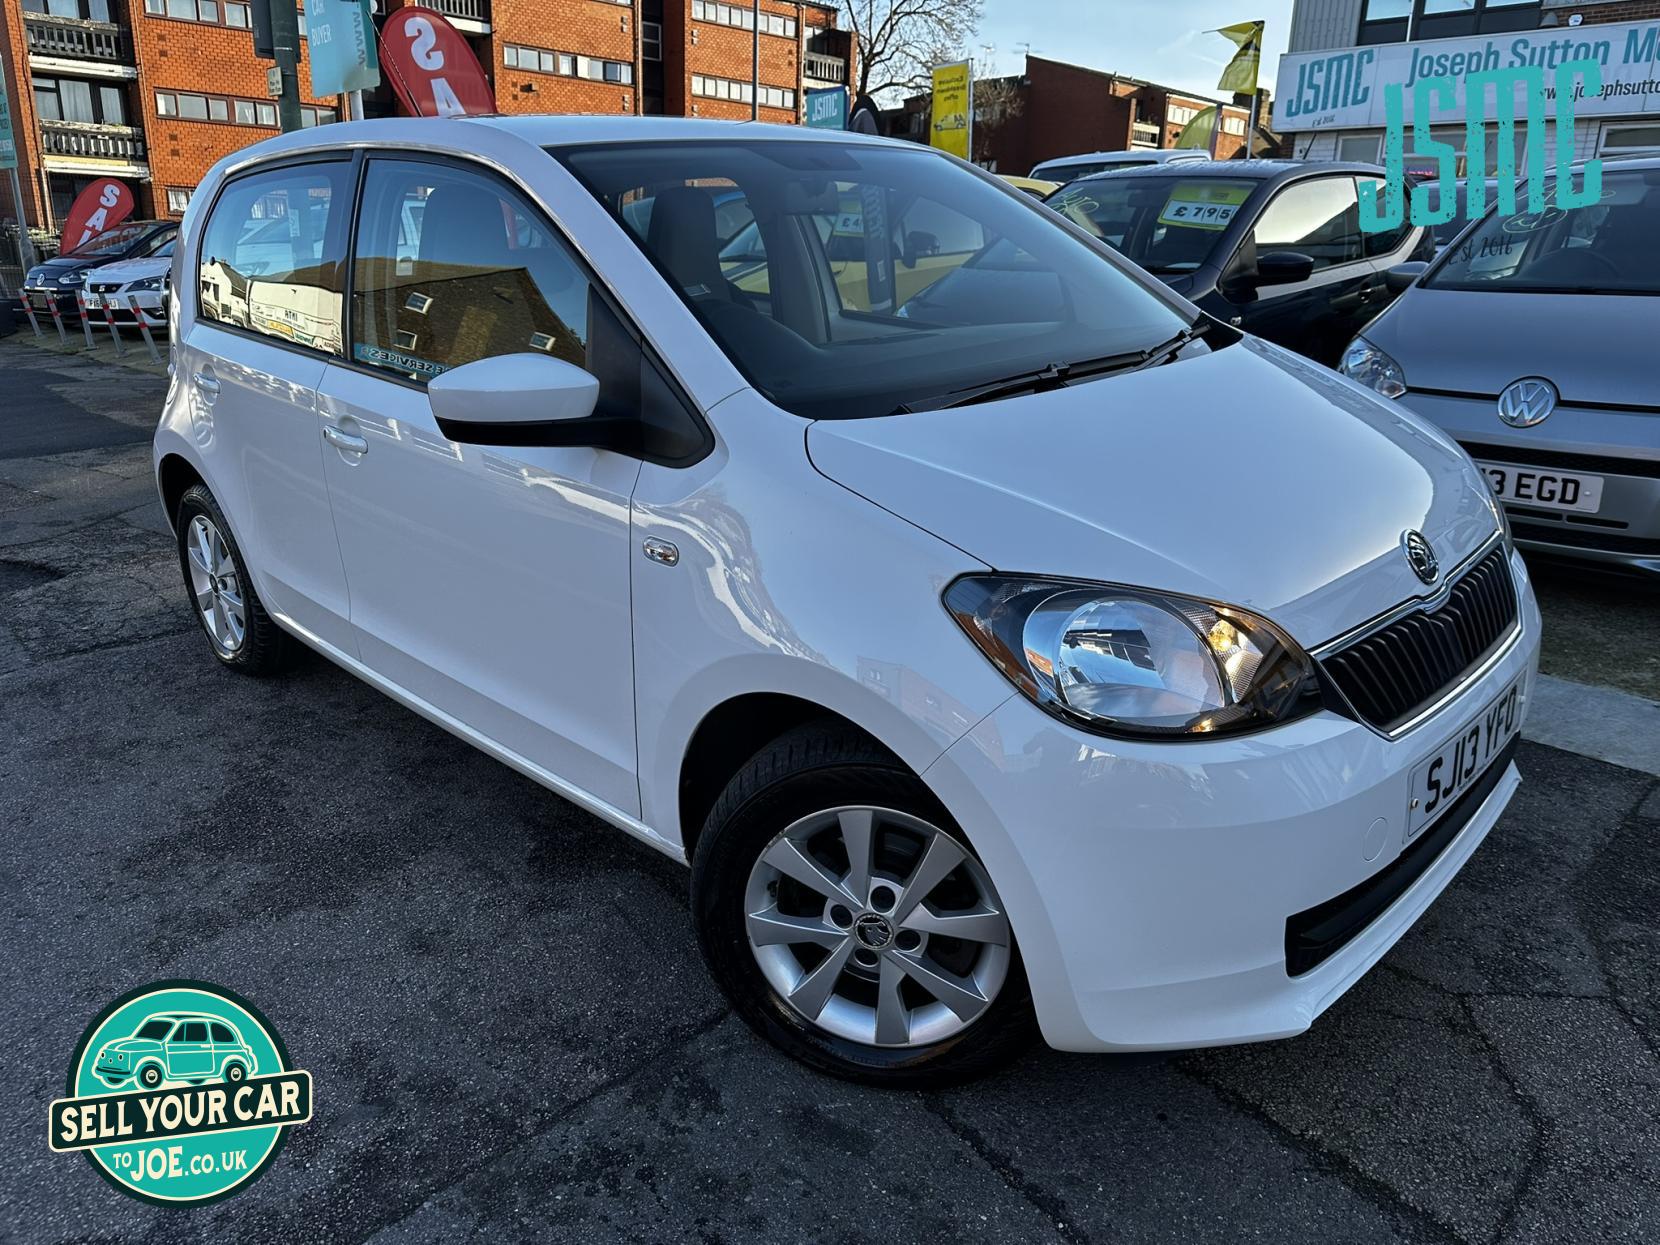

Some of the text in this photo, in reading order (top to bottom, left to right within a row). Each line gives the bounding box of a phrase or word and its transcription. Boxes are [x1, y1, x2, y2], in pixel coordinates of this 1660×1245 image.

[312, 24, 332, 47] BUYER
[1286, 49, 1374, 118] JSMC
[1405, 41, 1500, 88] Joseph
[1508, 38, 1611, 69] Sutton
[812, 93, 837, 121] JSMC
[1514, 472, 1581, 505] EGD
[1425, 725, 1480, 813] SJ13
